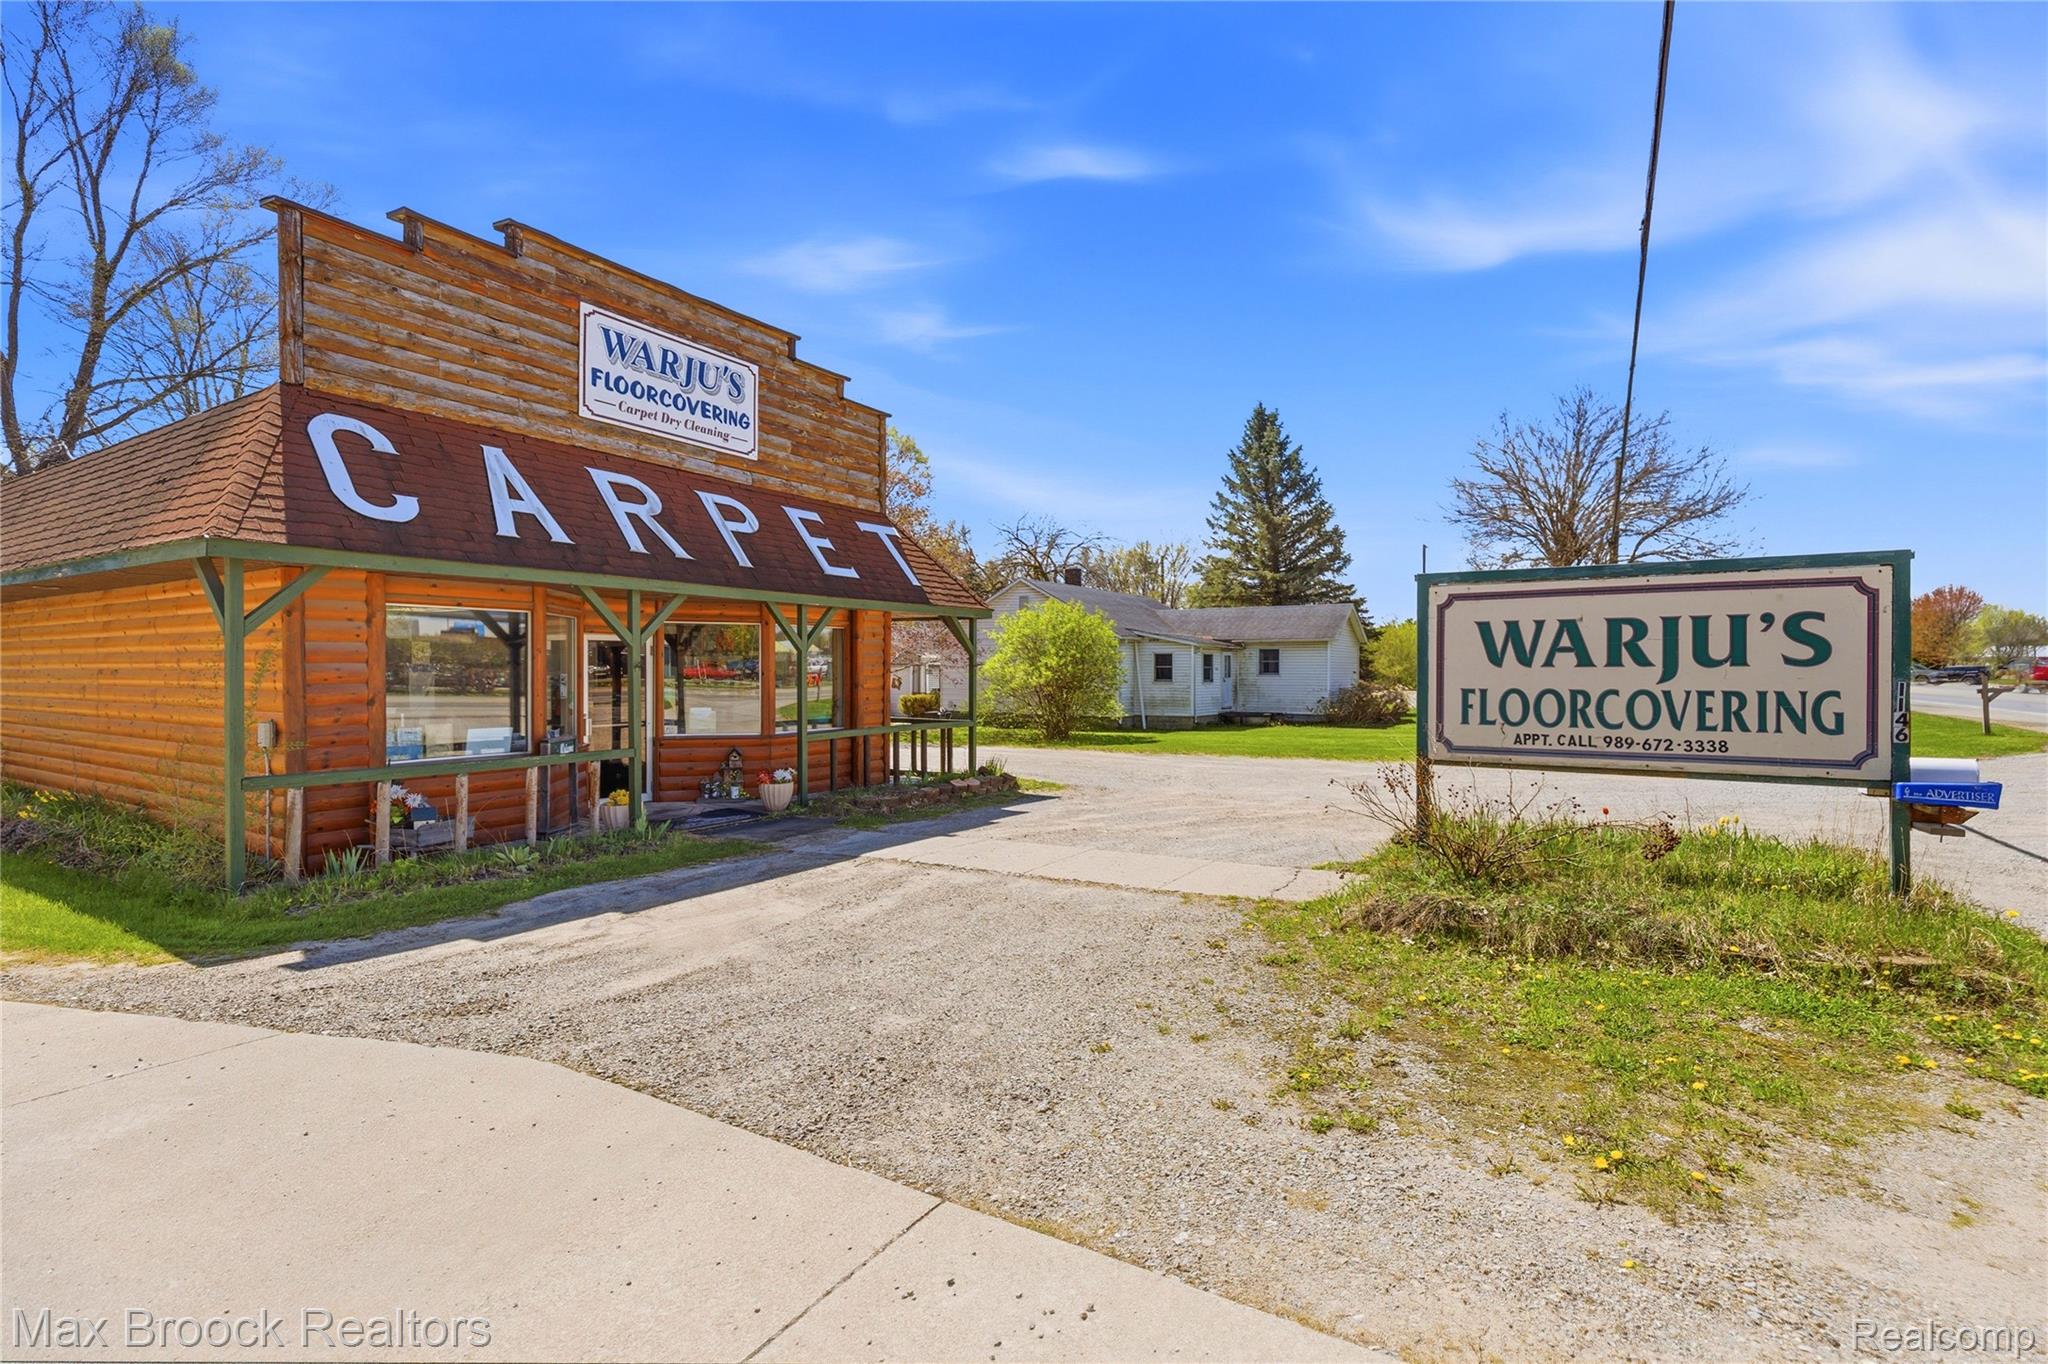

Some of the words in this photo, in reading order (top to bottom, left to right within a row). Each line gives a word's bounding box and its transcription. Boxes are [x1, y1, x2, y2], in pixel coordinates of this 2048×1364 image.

[599, 325, 744, 402] WARJU'S
[591, 367, 750, 429] FLOORCOVERING
[618, 400, 658, 422] Carpet
[661, 412, 682, 430] Dry
[684, 419, 730, 442] Cleaning
[307, 413, 922, 587] CARPET
[1474, 611, 1833, 685] WARJU'S
[1460, 688, 1845, 735] FLOORCOVERING
[1514, 734, 1552, 747] APPT.
[1557, 734, 1597, 748] CALL
[1603, 736, 1730, 754] 989-672-3338
[1926, 788, 1995, 803] ADVERTISER
